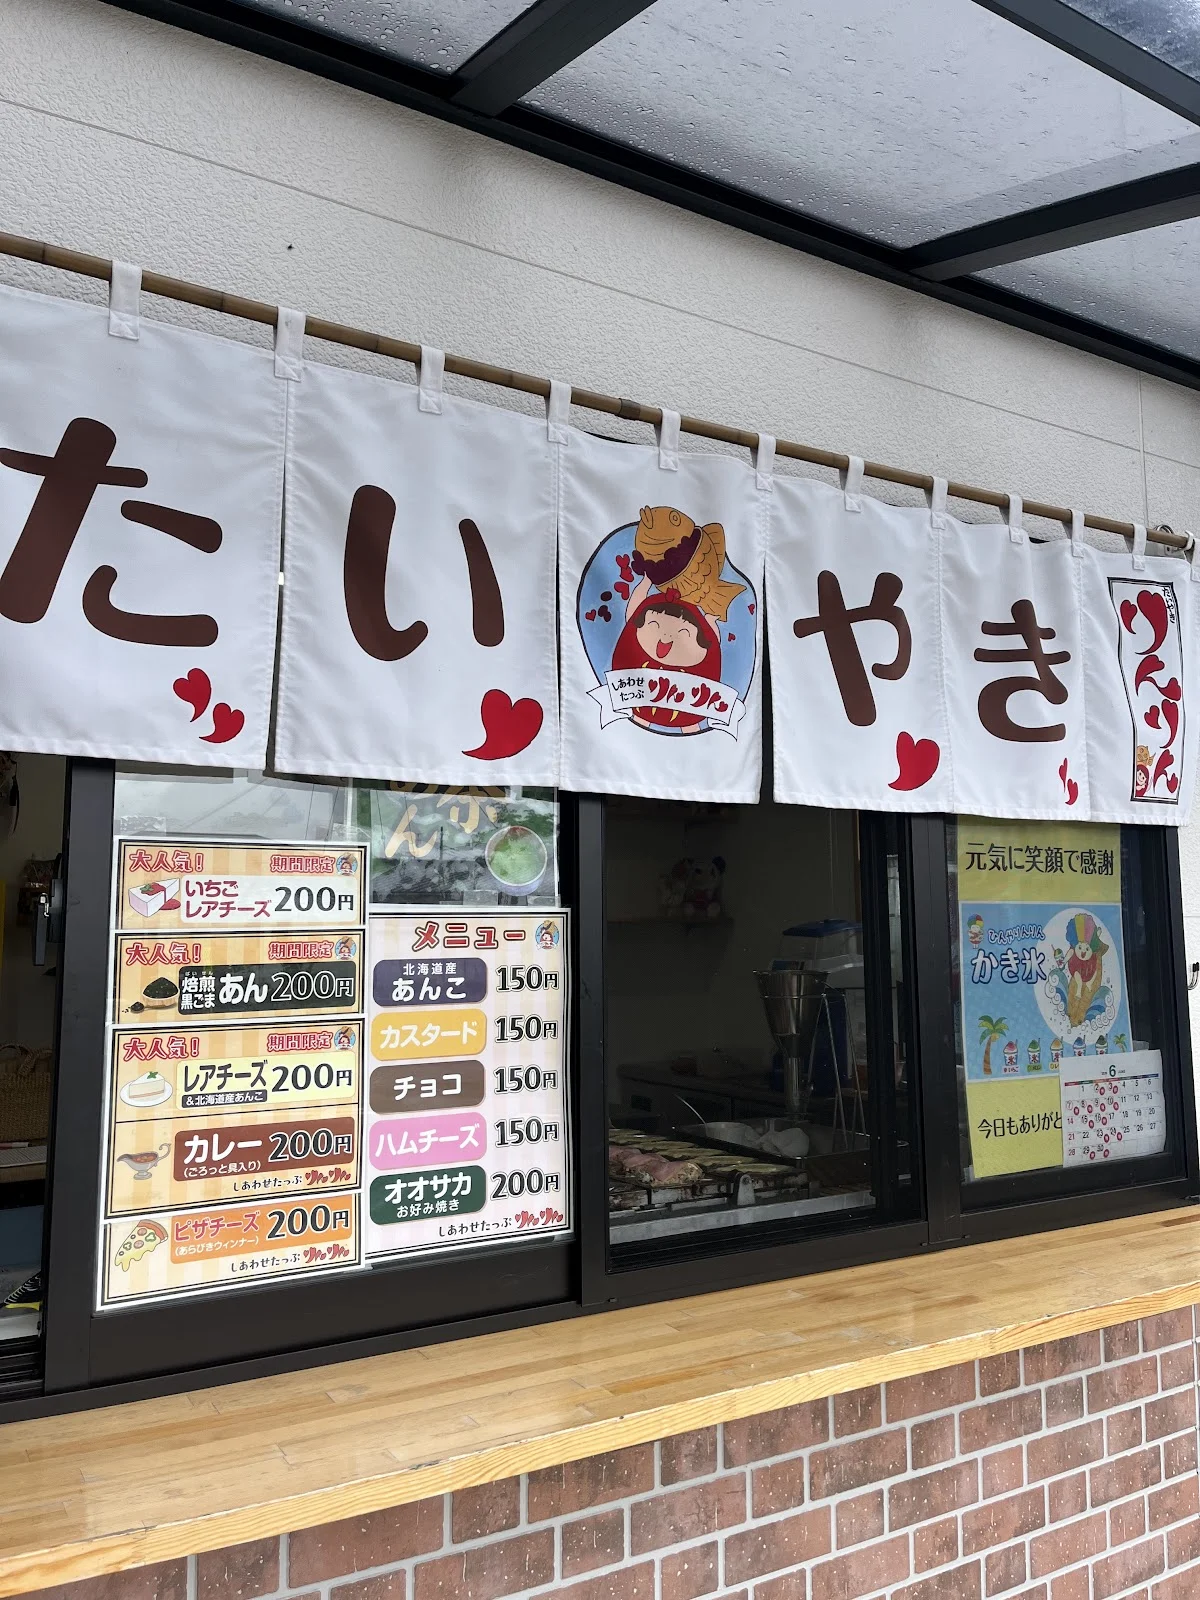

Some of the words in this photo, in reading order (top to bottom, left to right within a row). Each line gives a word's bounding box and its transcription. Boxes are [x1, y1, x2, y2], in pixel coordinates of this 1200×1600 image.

[611, 676, 645, 692] しあわせ
[620, 689, 645, 702] たっぷ
[270, 855, 336, 874] 期間限定
[965, 842, 1115, 876] 元気に笑顔で感謝
[185, 879, 239, 898] いちご
[274, 886, 354, 912] 200円
[185, 899, 272, 918] レアチーズ
[412, 921, 526, 952] メニュー
[268, 942, 334, 960] 期間限定
[402, 962, 458, 976] 北海道産
[971, 947, 1047, 985] かき氷
[181, 976, 216, 993] 焙煎
[219, 972, 269, 1005] あん
[271, 970, 355, 1001] 200円
[391, 977, 467, 1002] あんこ
[496, 964, 559, 992] 150円
[181, 993, 216, 1010] 黒ごま
[267, 1031, 333, 1052] 期間限定
[380, 1021, 478, 1049] カスタード
[494, 1014, 558, 1043] 150円
[184, 1059, 268, 1092] レアチーズ
[271, 1063, 352, 1093] 200円
[393, 1074, 462, 1100] チョコ
[494, 1064, 557, 1094] 150円
[1109, 1064, 1116, 1077] 6
[375, 1123, 480, 1158] ハムチーズ
[494, 1116, 559, 1148] 150円
[978, 1111, 1063, 1138] 今日もありがと
[183, 1133, 262, 1164] カレー
[267, 1129, 352, 1163] 200円
[384, 1171, 472, 1204] オオサカ
[490, 1167, 560, 1201] 200円
[396, 1198, 460, 1218] お好み焼き
[174, 1212, 260, 1242] ピザチーズ
[266, 1204, 350, 1240] 200円
